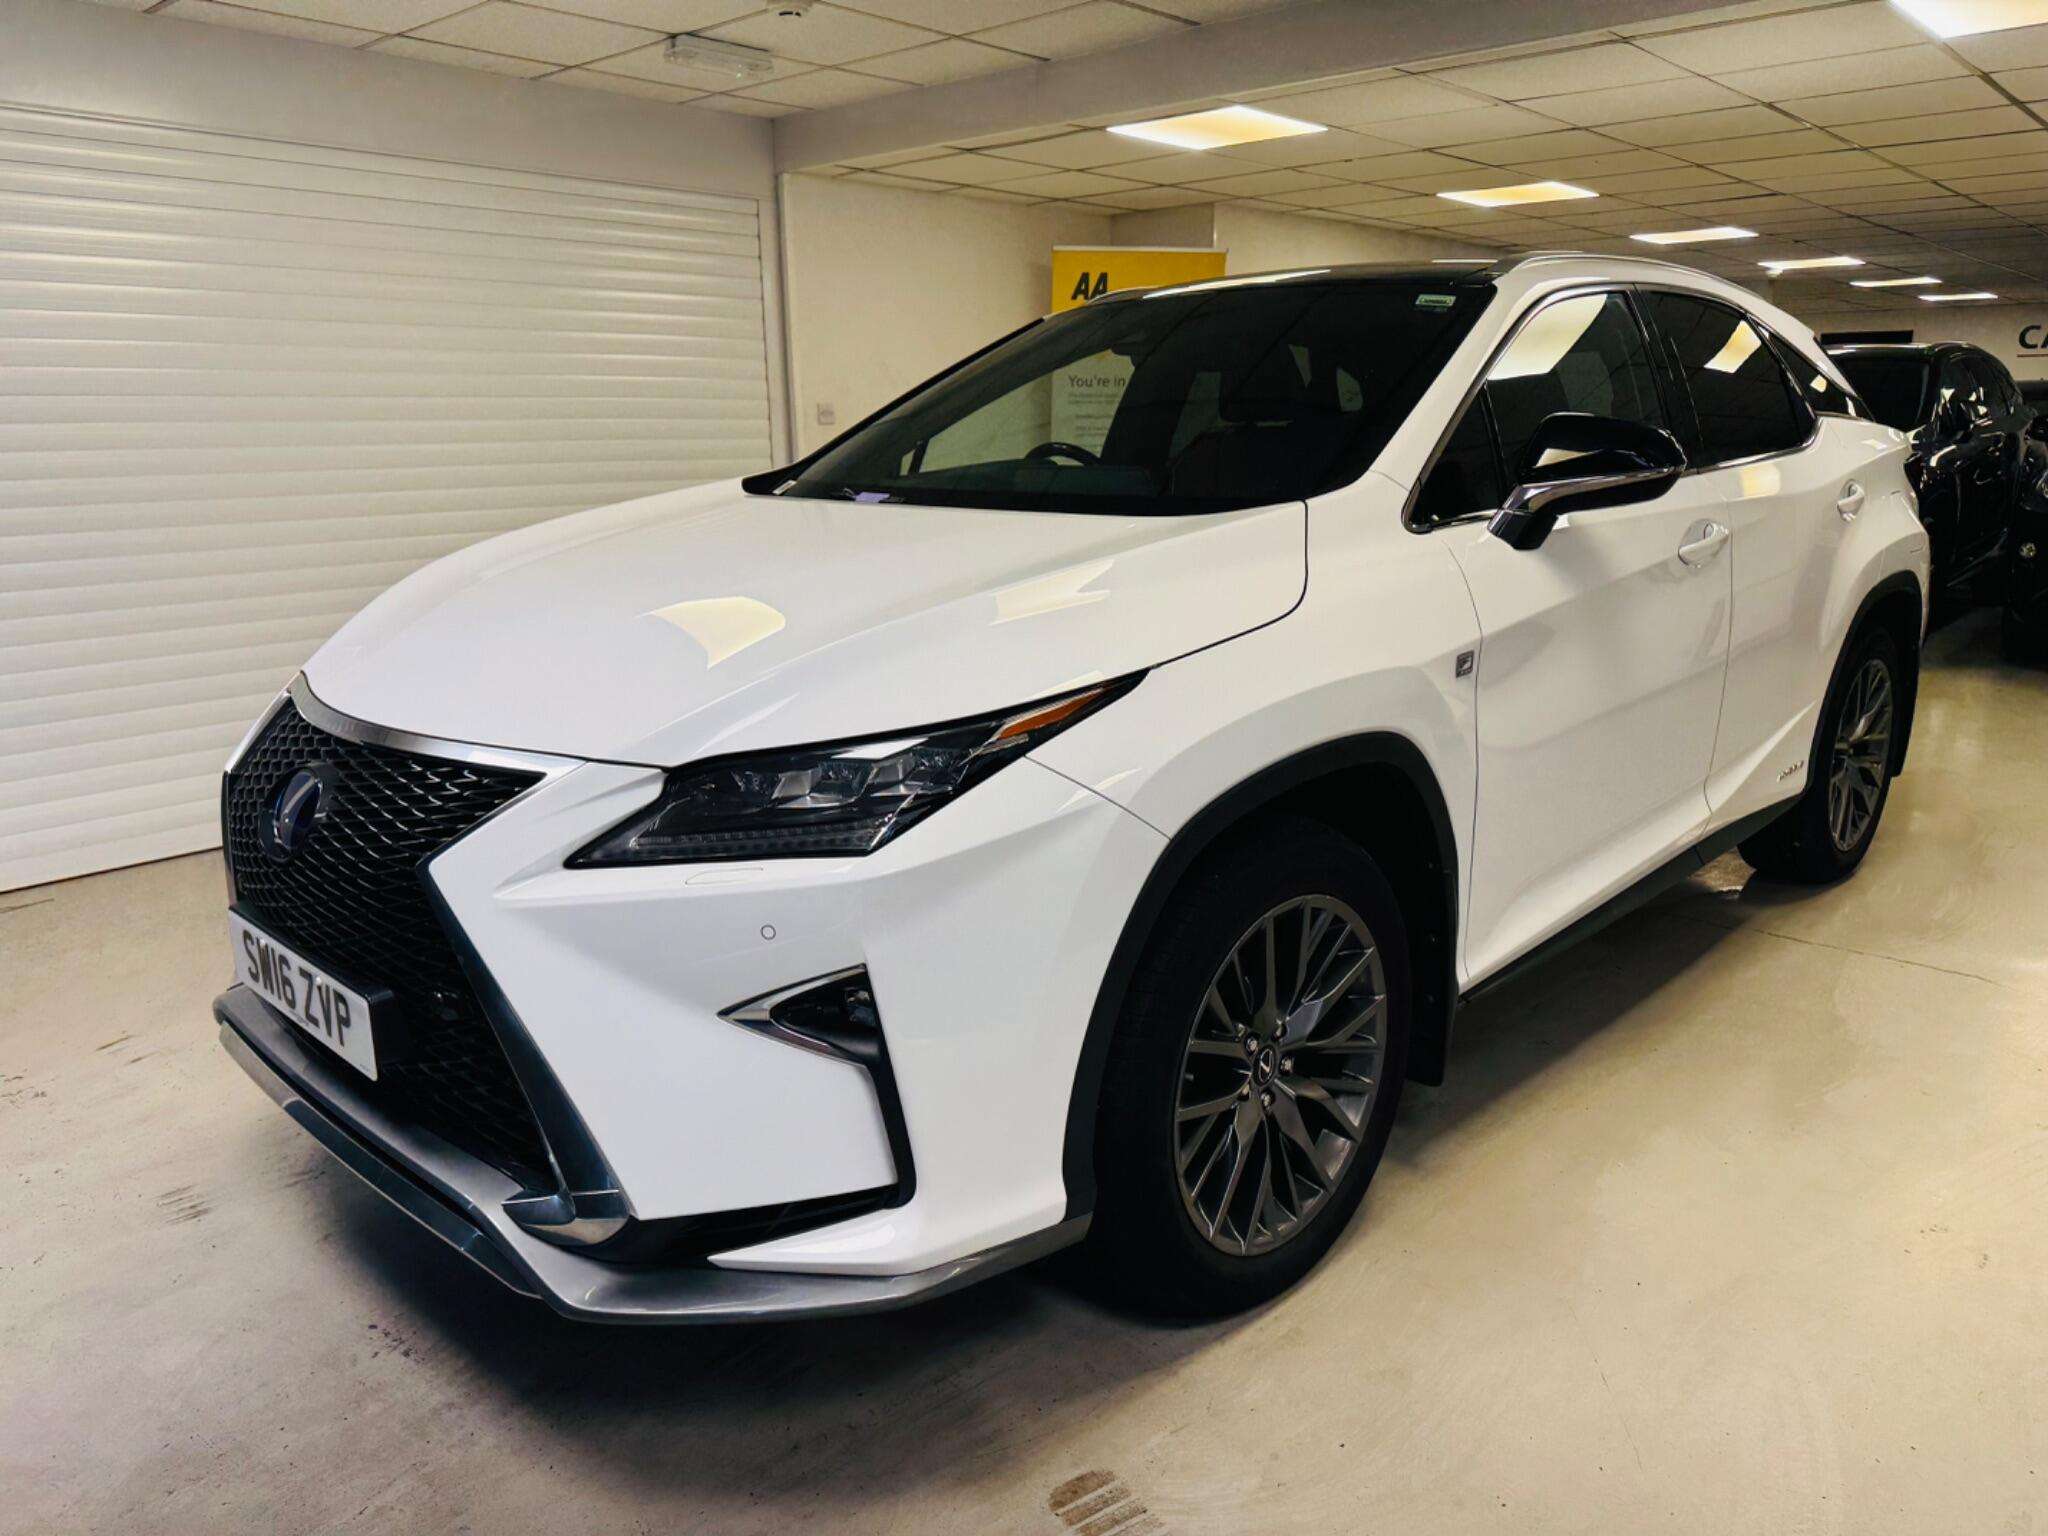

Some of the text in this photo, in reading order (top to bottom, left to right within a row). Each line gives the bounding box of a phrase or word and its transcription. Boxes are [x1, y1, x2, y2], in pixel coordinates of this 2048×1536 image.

[1072, 272, 1108, 300] AA
[1068, 375, 1110, 388] You're
[242, 929, 351, 1047] SW16 ZVP
